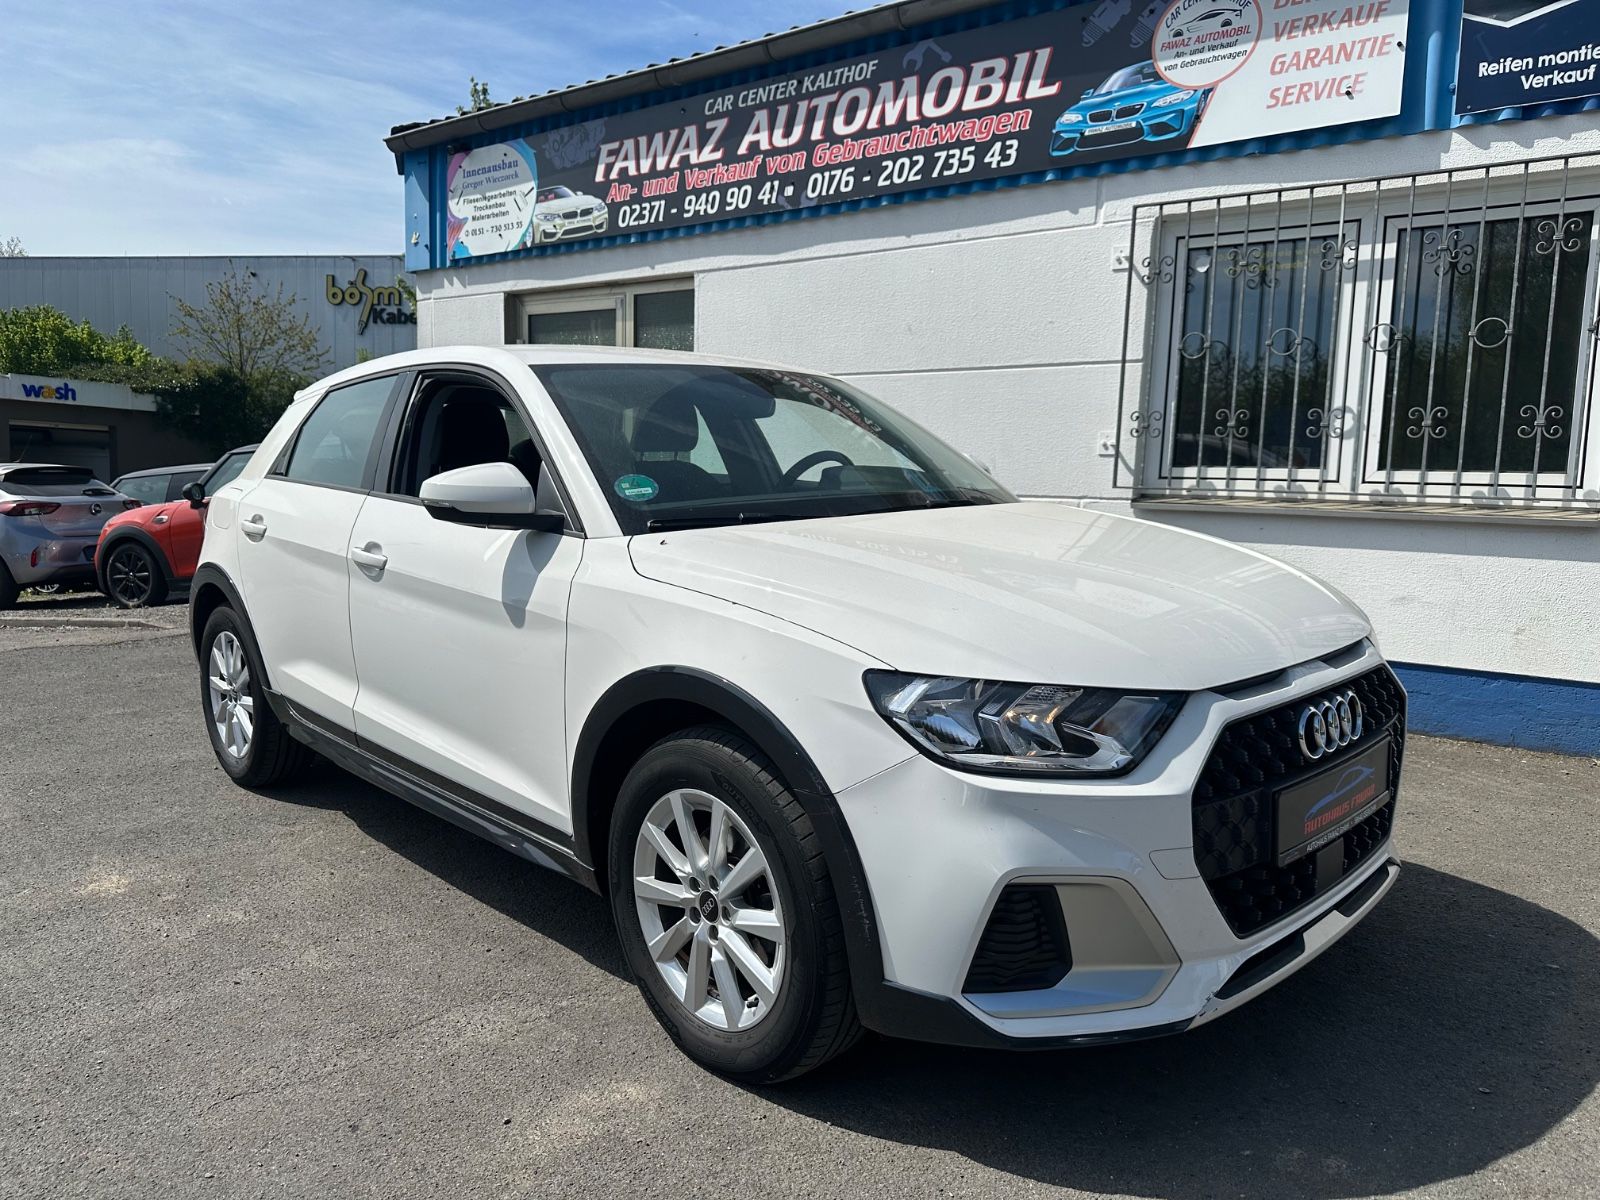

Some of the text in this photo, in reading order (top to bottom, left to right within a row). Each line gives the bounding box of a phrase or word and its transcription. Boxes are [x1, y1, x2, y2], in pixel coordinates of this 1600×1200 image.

[1165, 6, 1181, 28] CAR
[1273, 0, 1391, 42] VERKAUF
[1160, 25, 1252, 52] FAWAZ AUTOMOBIL
[1173, 38, 1239, 59] An- und Verkauf
[1163, 49, 1248, 72] von Gebrauchtwagen
[1269, 33, 1395, 76] GARANTIE
[1478, 57, 1533, 77] Reifen
[705, 59, 878, 115] CAR CENTER KALTHOF
[1266, 71, 1368, 109] SERVICE
[1520, 64, 1597, 90] Verkauf
[594, 46, 1062, 182] FAWAZ AUTOMOBIL
[606, 108, 1032, 203] An- und Verkauf von Gebrauchtwagen
[462, 159, 519, 179] Innenausbau
[618, 199, 665, 228] 02371
[683, 190, 720, 218] 940
[725, 184, 752, 211] 90
[757, 180, 780, 205] 41
[806, 166, 855, 198] 0176
[877, 154, 925, 187] 202
[931, 145, 976, 178] 735
[983, 138, 1019, 169] 43
[471, 210, 510, 221] Malerarbeiten
[473, 202, 506, 212] Trockenbau
